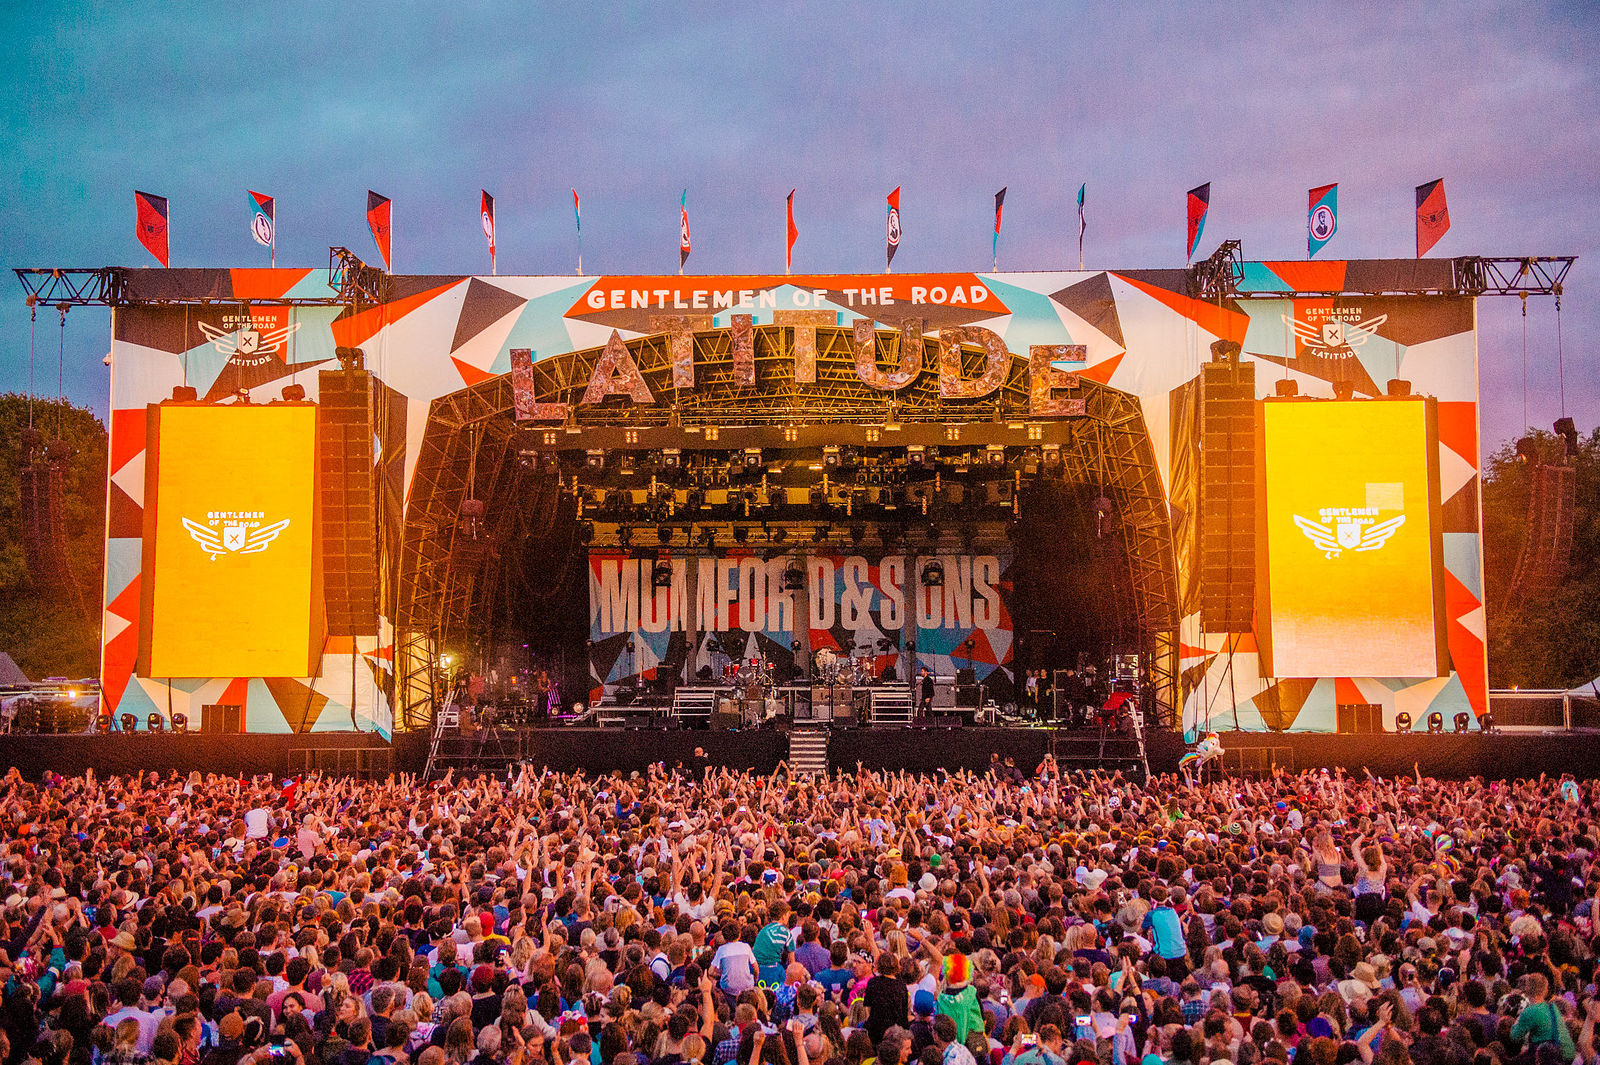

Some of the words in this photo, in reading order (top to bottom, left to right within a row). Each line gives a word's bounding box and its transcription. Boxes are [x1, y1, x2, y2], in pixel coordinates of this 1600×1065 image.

[587, 289, 777, 309] GENTLEMEN
[793, 289, 828, 308] OF
[843, 287, 895, 306] THE
[911, 285, 988, 305] ROAD
[1305, 307, 1362, 315] GENTLEMEN
[224, 354, 272, 367] LATITUDE
[509, 309, 1088, 421] LATITUDE
[207, 511, 265, 519] GENTLEMEN
[601, 556, 835, 633] MUMFORD
[841, 555, 874, 631] &
[880, 555, 1000, 631] SONS
